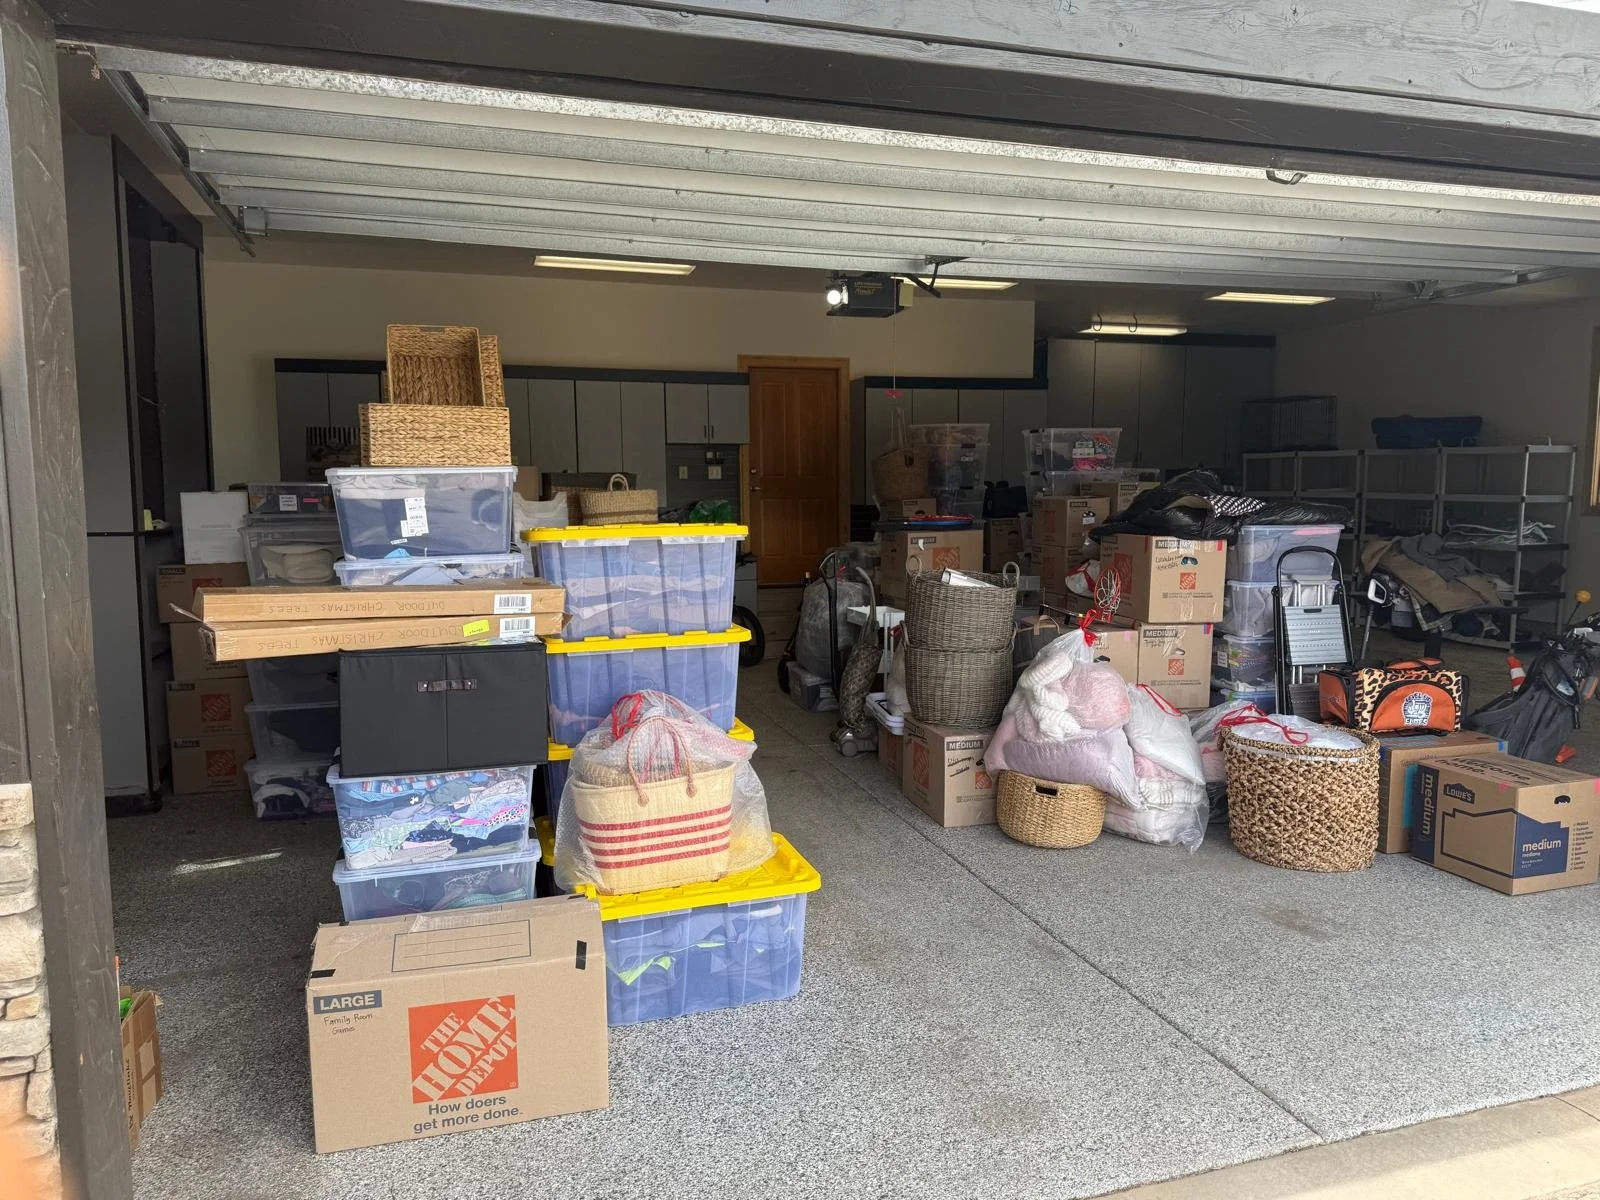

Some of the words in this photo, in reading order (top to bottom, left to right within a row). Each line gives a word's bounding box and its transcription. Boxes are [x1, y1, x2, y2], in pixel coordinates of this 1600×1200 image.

[267, 604, 309, 615] TREES
[320, 601, 383, 614] CHRISTMAS
[395, 599, 446, 613] OUTDOOR
[311, 631, 384, 647] CHRISTMAS
[948, 741, 981, 750] MEDIUM
[1422, 774, 1434, 835] medium
[1522, 838, 1562, 852] medium
[320, 994, 376, 1011] LARGE
[323, 1015, 350, 1027] Family
[354, 1013, 373, 1022] Room
[420, 1012, 464, 1053] THE
[412, 997, 516, 1101] HOME
[454, 1030, 518, 1096] DEPOT
[428, 1102, 461, 1115] How
[465, 1096, 507, 1110] doers
[413, 1119, 438, 1134] get
[441, 1113, 479, 1128] more
